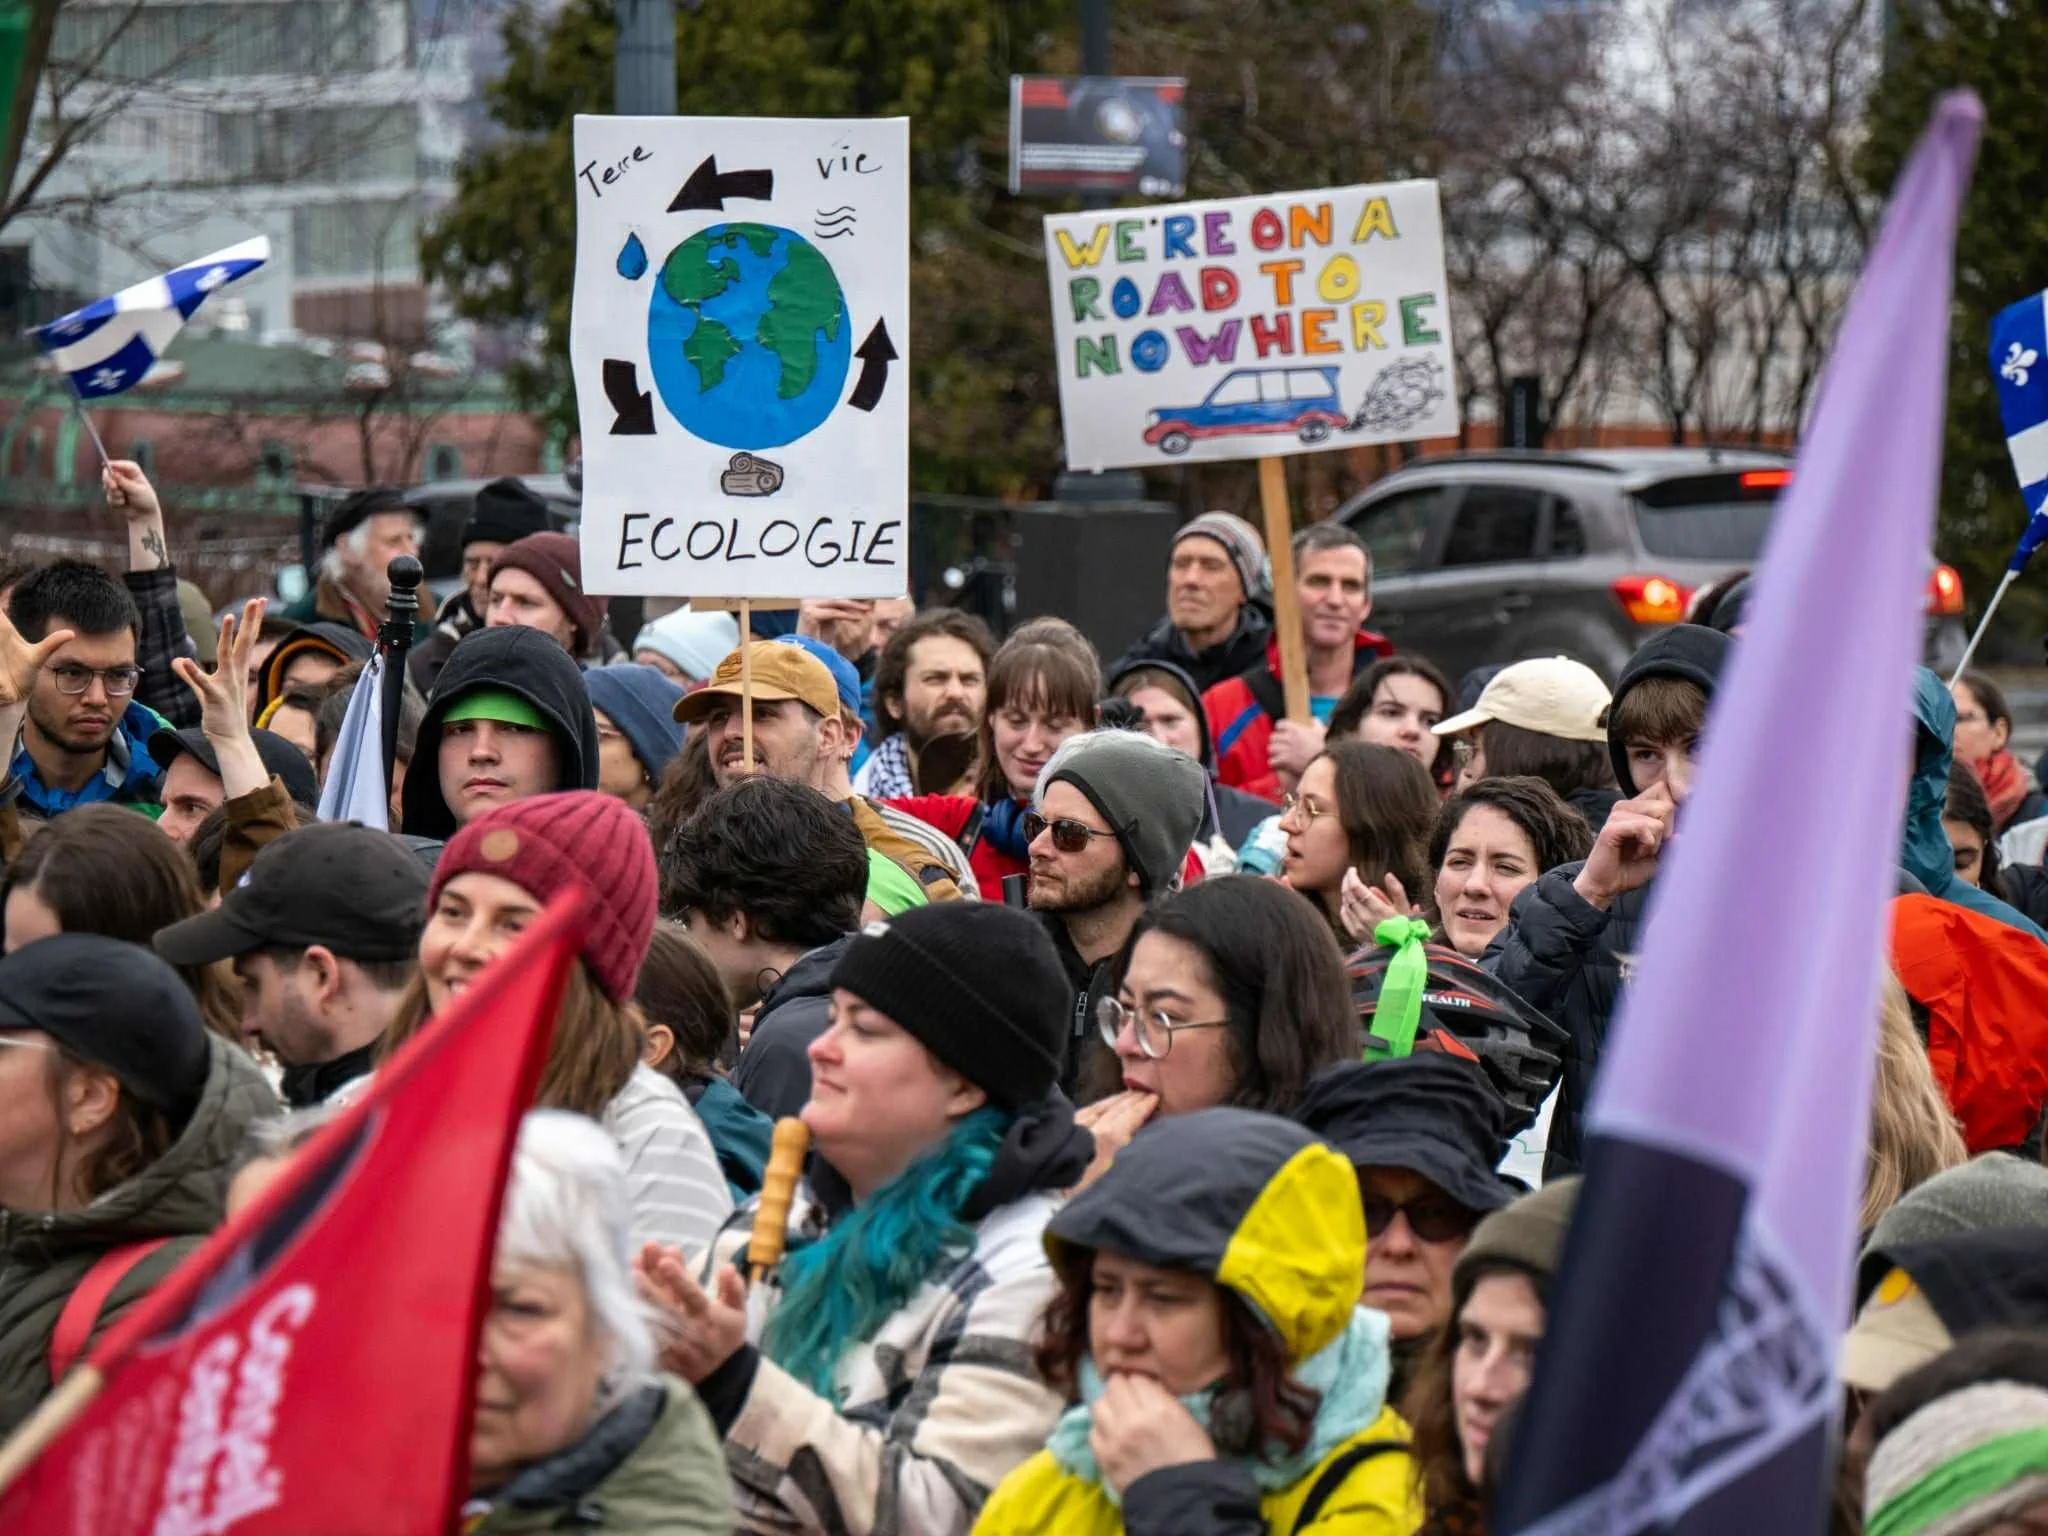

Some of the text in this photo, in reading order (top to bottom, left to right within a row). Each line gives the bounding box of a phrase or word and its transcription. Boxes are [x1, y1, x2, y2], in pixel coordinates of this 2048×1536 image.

[579, 145, 654, 197] Terre
[1055, 197, 1399, 268] WE'RE ON A
[1070, 253, 1360, 322] ROAD TO
[1076, 293, 1440, 377] NOWHERE
[617, 513, 901, 570] ECOLOGIE
